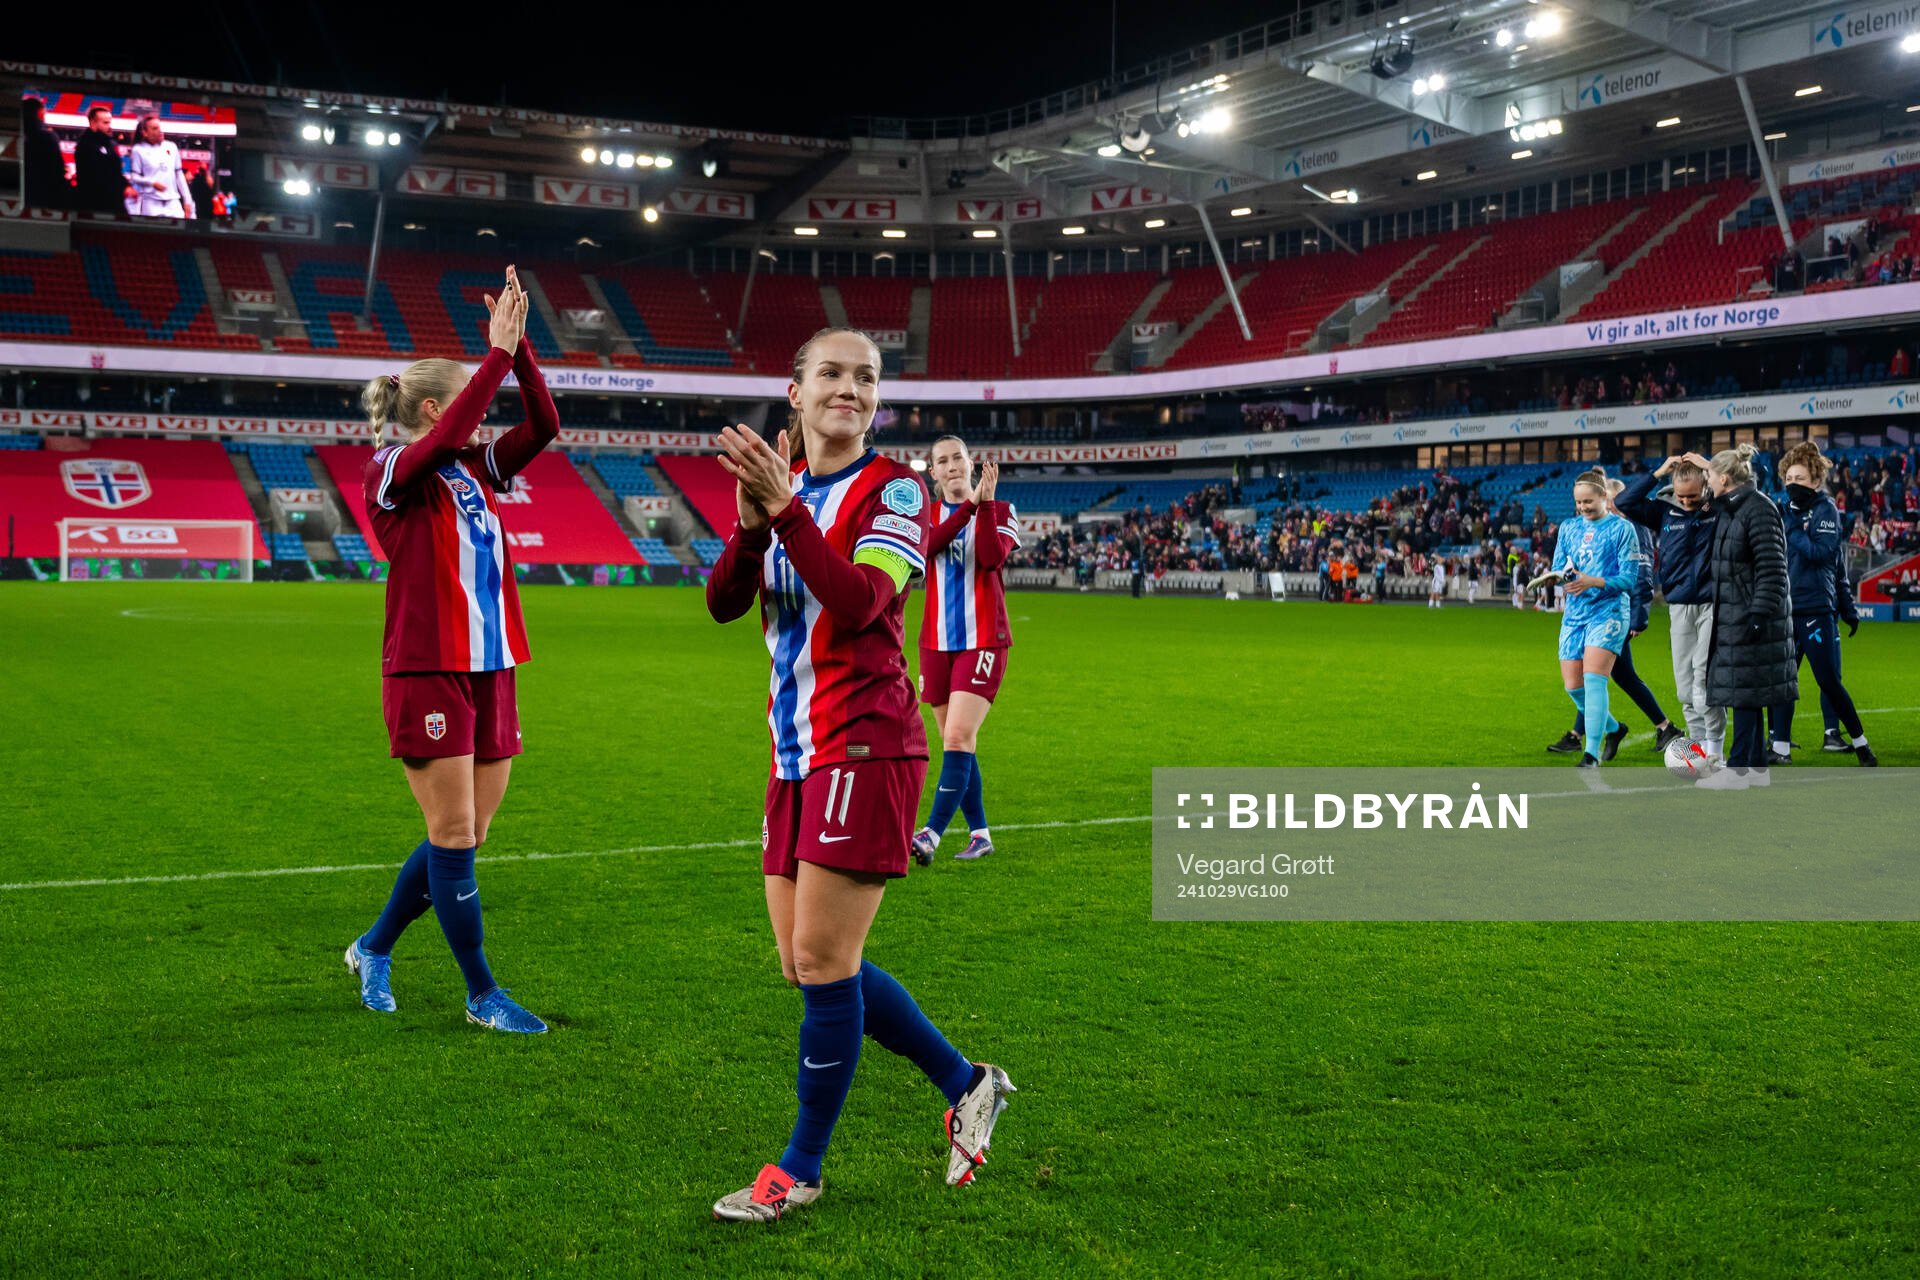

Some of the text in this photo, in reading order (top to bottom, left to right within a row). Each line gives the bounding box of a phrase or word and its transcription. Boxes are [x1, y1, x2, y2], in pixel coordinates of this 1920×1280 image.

[1846, 6, 1919, 38] telenor
[1604, 68, 1663, 96] telenor
[411, 169, 496, 197] VG
[547, 180, 630, 208] VG
[668, 190, 744, 217] VG
[812, 200, 895, 219] VG
[961, 200, 1041, 219] VG
[234, 290, 275, 304] VG
[1587, 306, 1780, 343] Vi gir alt, alt for Norge
[557, 373, 578, 385] alt
[582, 373, 604, 386] for
[609, 376, 655, 391] Norge
[1586, 413, 1616, 426] telenor
[1657, 408, 1689, 421] telenor
[1733, 404, 1768, 416] telenor
[1815, 397, 1854, 410] telenor
[35, 412, 83, 425] VG
[96, 415, 145, 428] VG
[158, 417, 206, 430] VG
[219, 419, 267, 432] VG
[280, 421, 325, 434] VG
[608, 433, 650, 445] VG
[659, 435, 700, 447] VG
[1006, 449, 1048, 462] VG
[1056, 449, 1097, 460] VG
[1101, 448, 1141, 460] VG
[1144, 446, 1176, 458] VG
[278, 490, 323, 503] VG
[635, 497, 672, 509] VG
[466, 504, 487, 535] 5
[126, 528, 169, 541] 5G
[777, 555, 799, 612] 11
[975, 649, 996, 679] 19
[824, 767, 856, 828] 11
